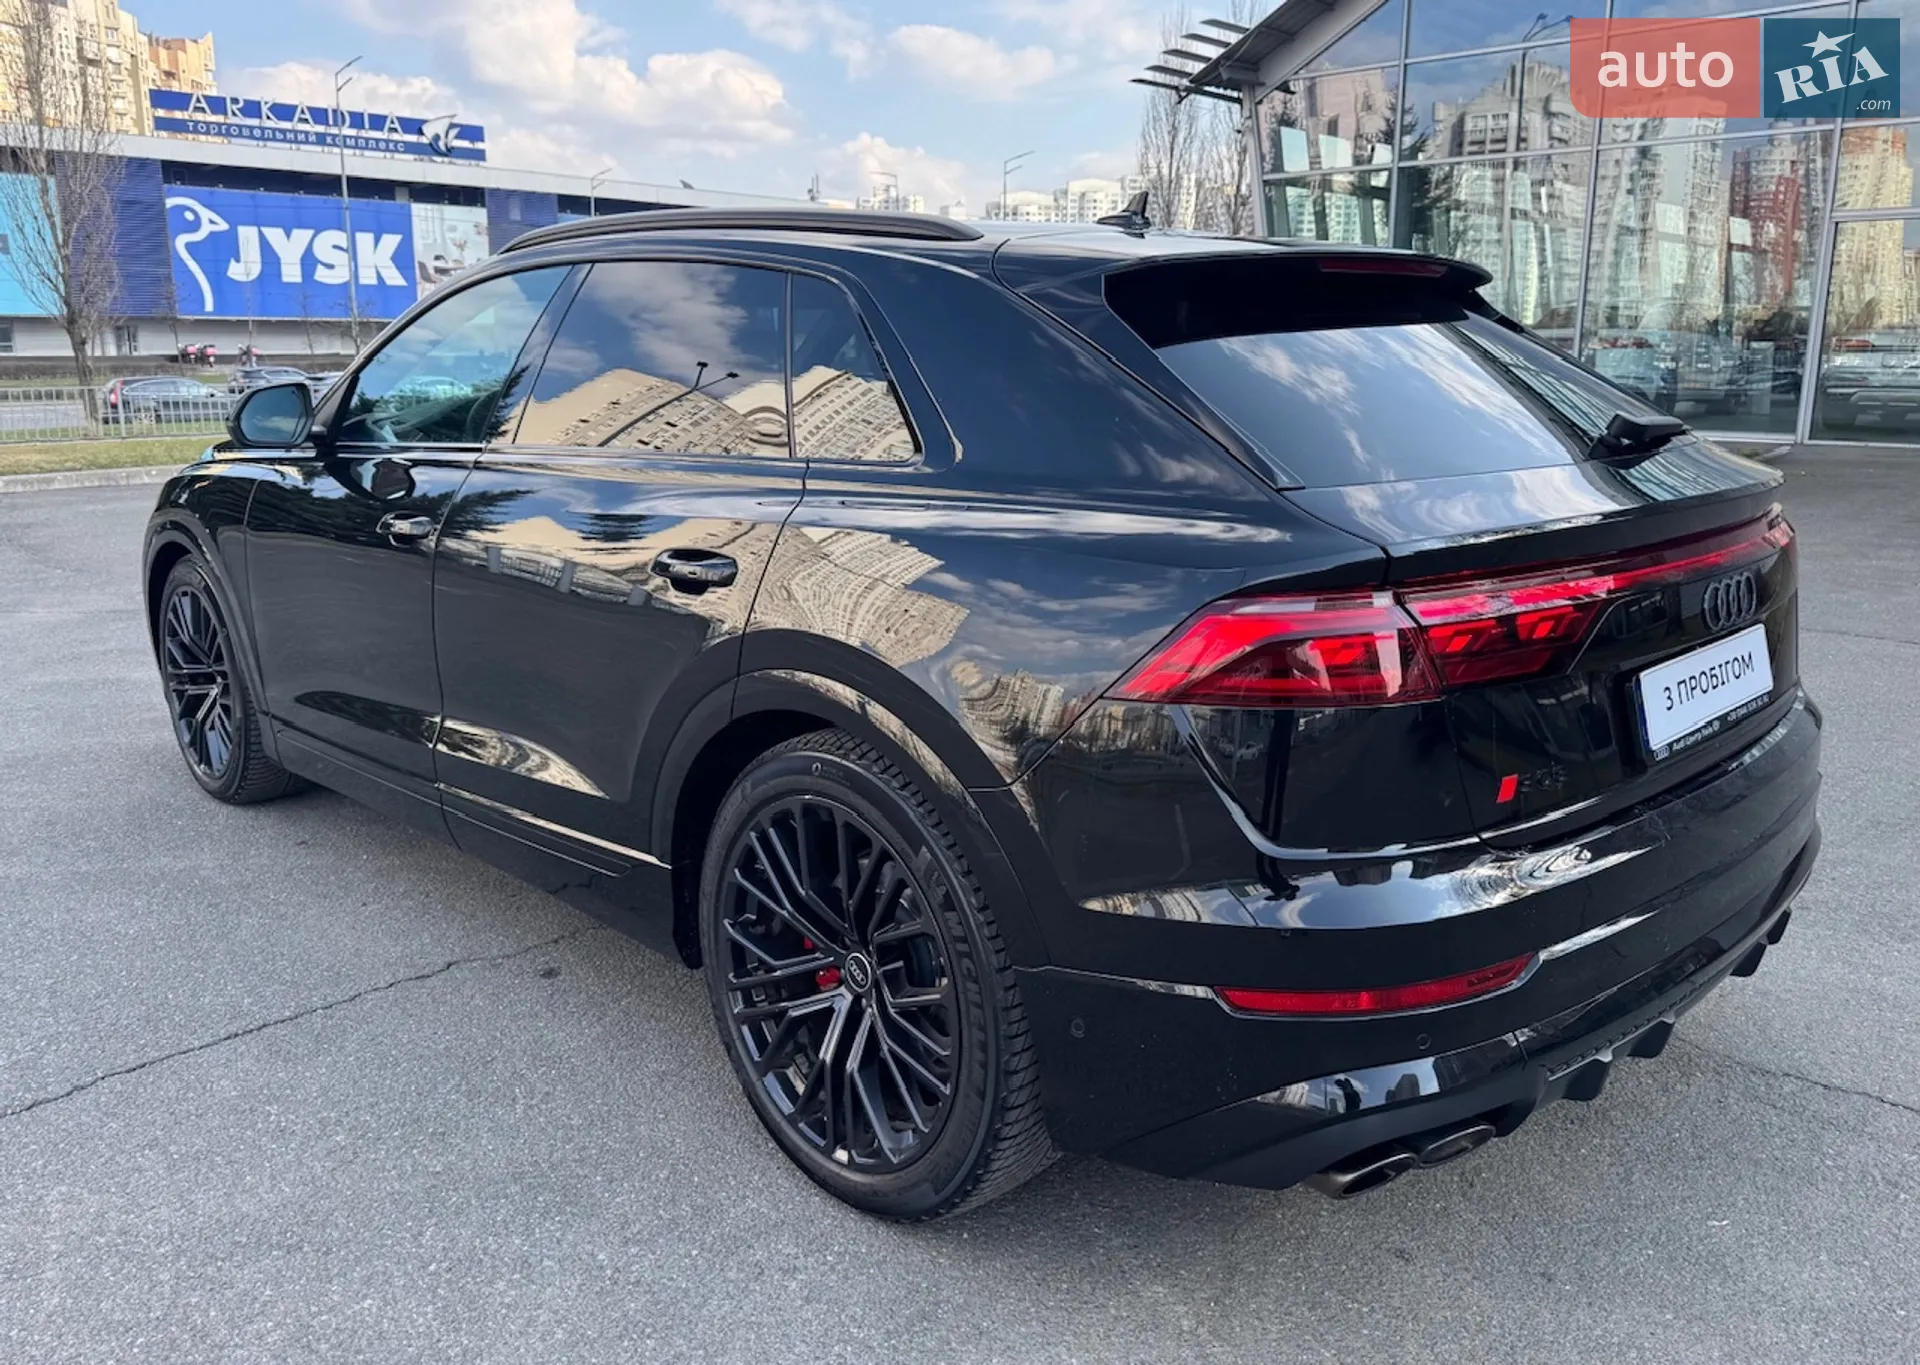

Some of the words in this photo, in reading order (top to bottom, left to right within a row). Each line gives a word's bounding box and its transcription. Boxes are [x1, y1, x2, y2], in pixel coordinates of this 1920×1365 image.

[187, 92, 405, 138] ARKADIA
[226, 224, 409, 287] JYSK
[1677, 651, 1755, 705] ПРОБІГОМ
